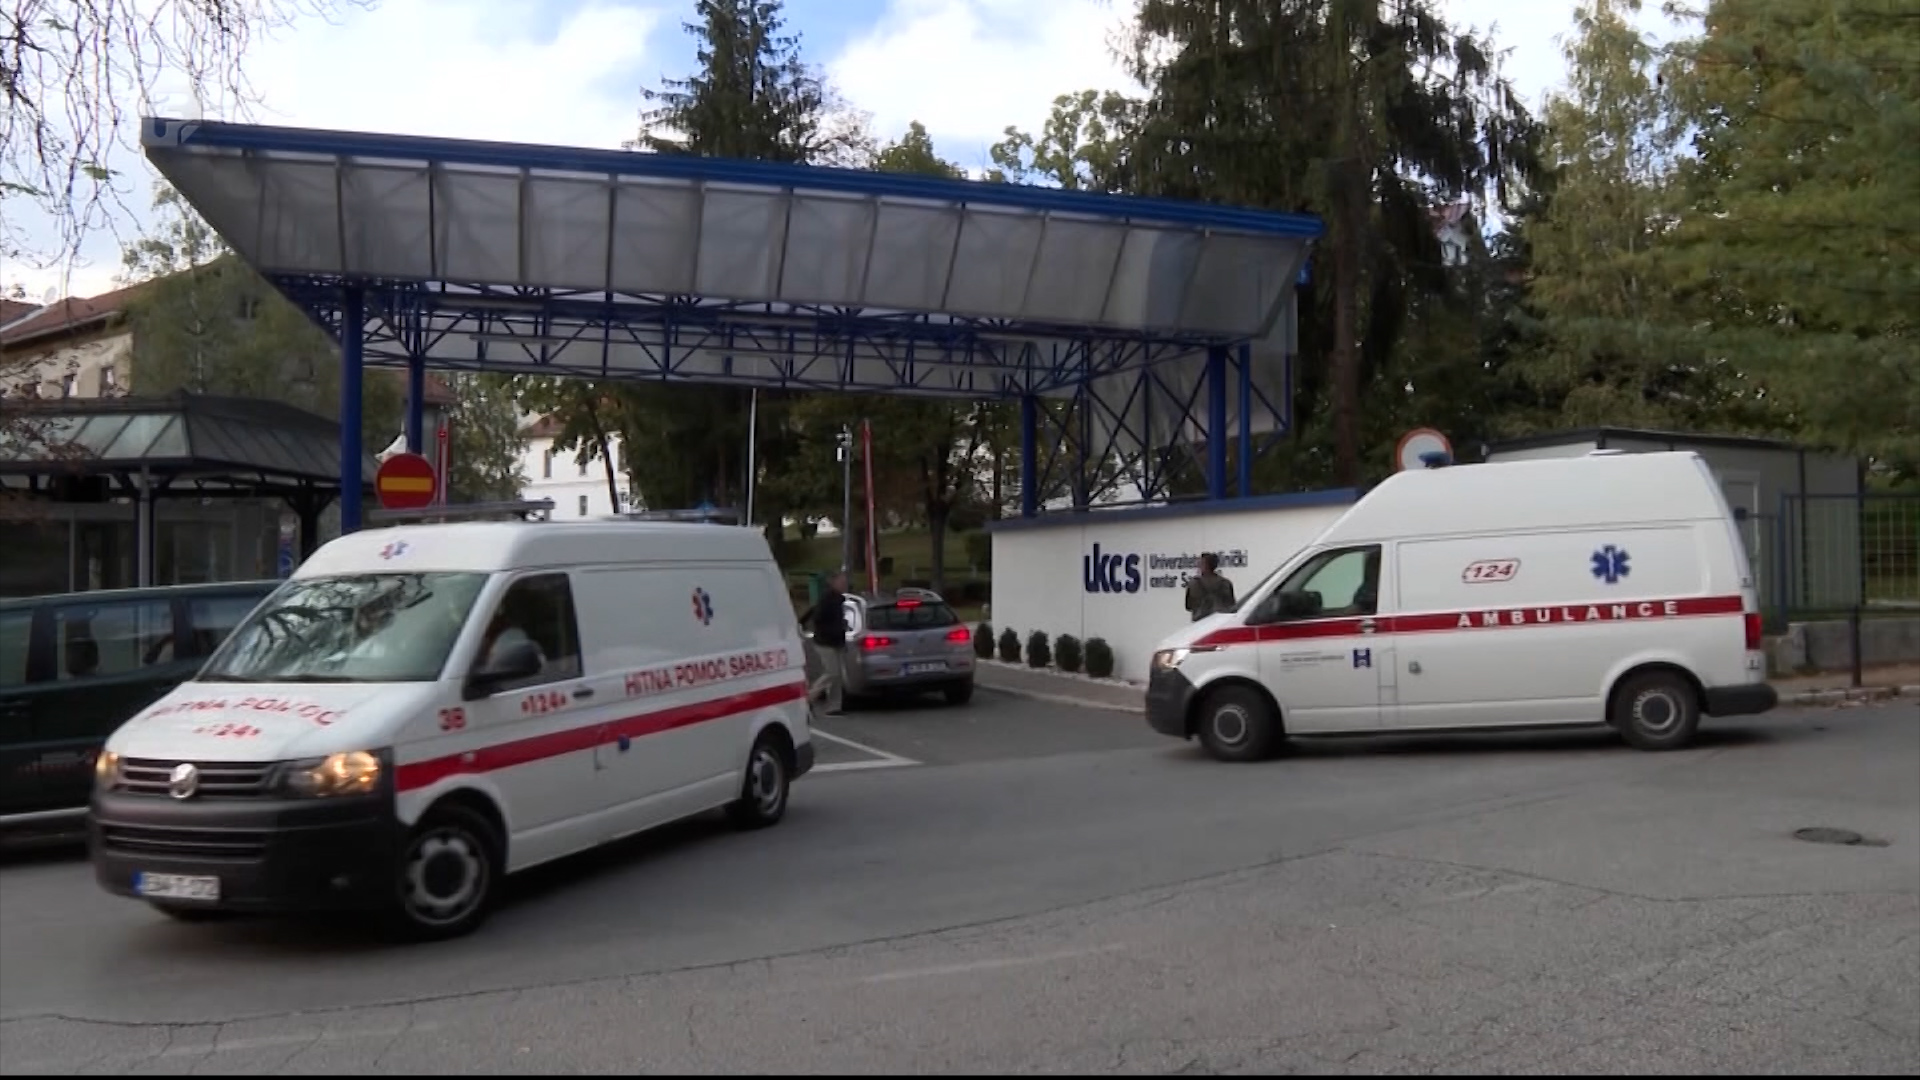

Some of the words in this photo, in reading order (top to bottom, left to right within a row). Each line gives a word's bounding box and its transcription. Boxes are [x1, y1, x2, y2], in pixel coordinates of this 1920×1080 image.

[1473, 564, 1514, 578] 124
[1457, 601, 1678, 628] AMBULANCE
[624, 668, 674, 697] HITNA
[728, 648, 789, 677] SARAJEVO
